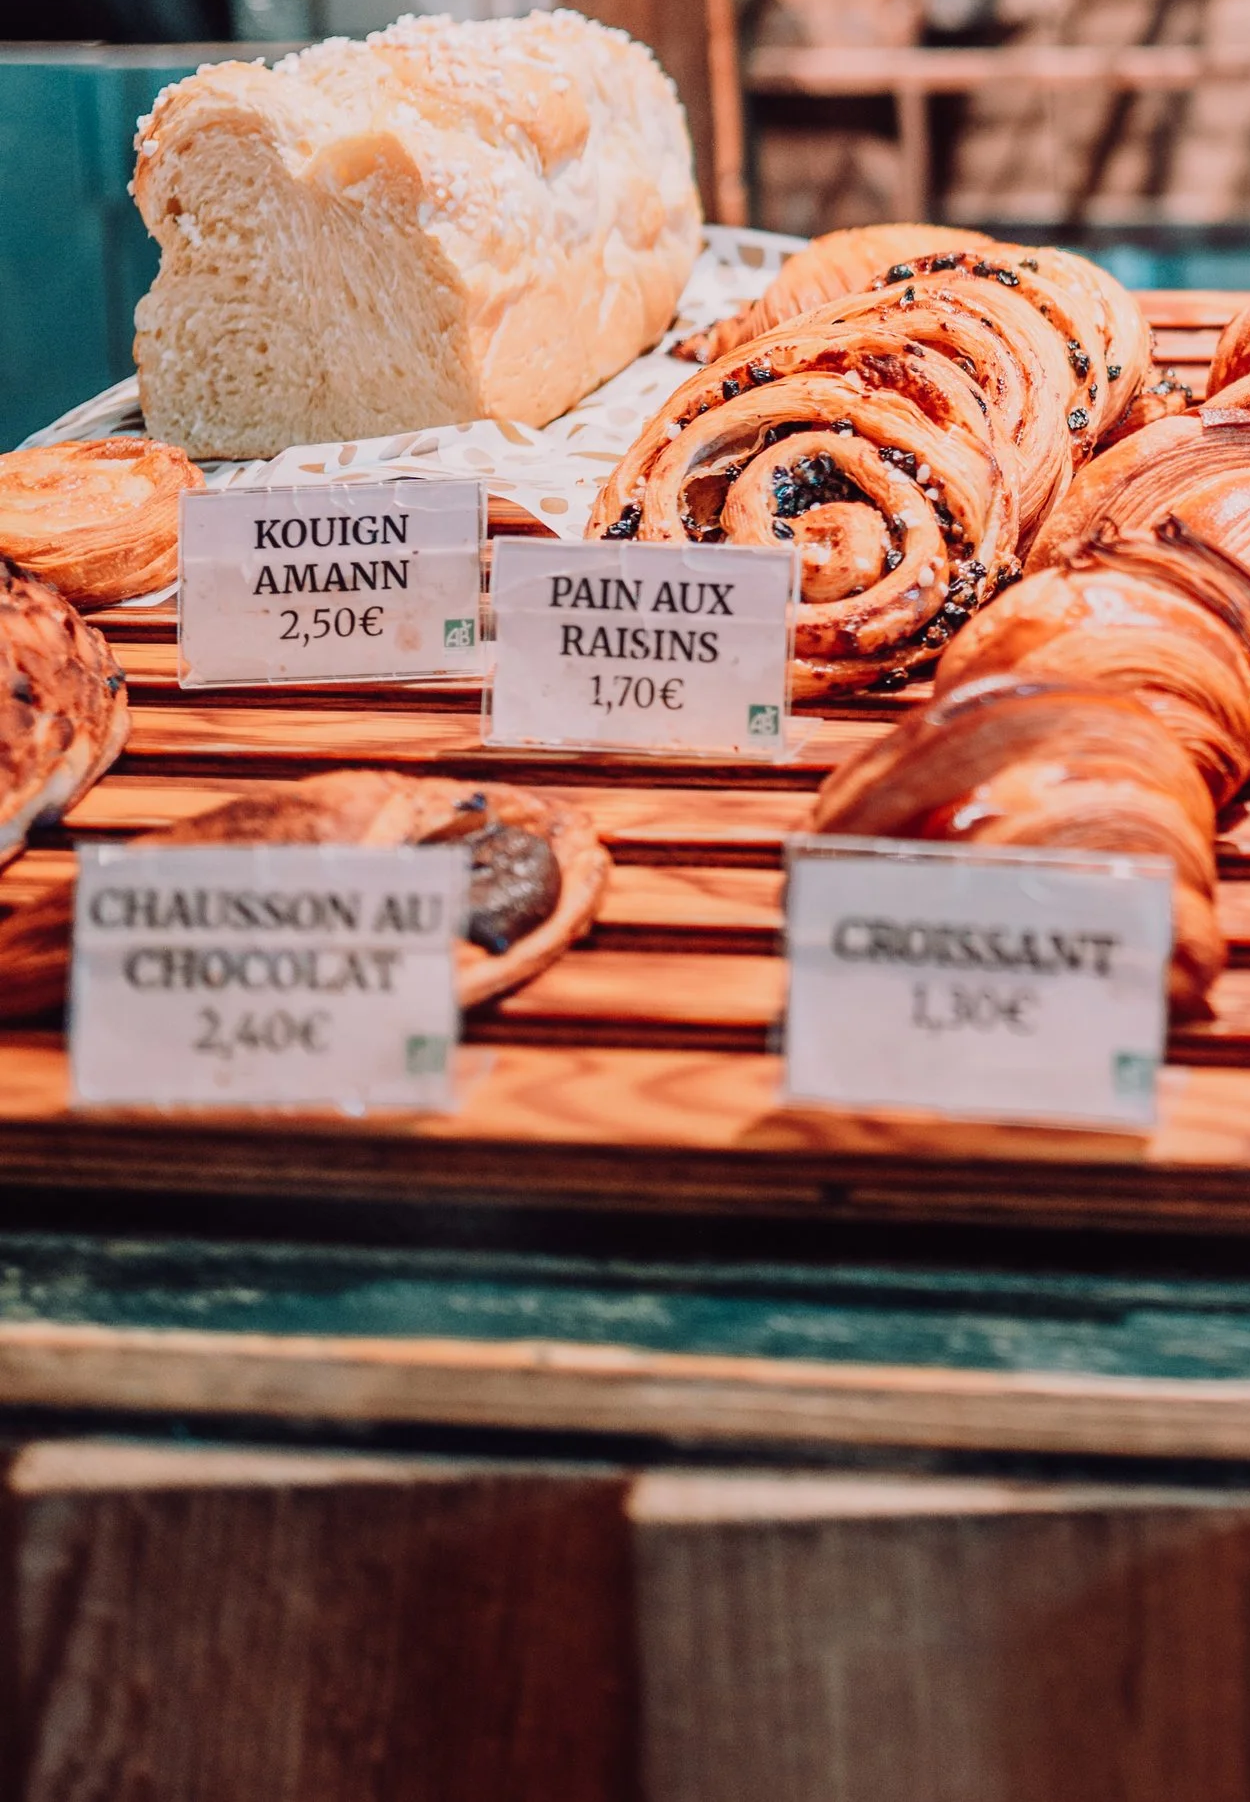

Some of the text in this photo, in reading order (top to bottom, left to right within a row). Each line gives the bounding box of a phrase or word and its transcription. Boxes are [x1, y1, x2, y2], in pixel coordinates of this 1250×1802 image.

[254, 514, 409, 550] KOUIGN
[252, 559, 410, 596] AMANN
[549, 575, 735, 616] PAIN AUX
[279, 606, 384, 648] 2,50€
[560, 625, 719, 664] RAISINS
[590, 674, 684, 714] 1,70€
[89, 888, 443, 933] CHAUSSON AU
[830, 915, 1119, 976] CROISSANT
[123, 946, 399, 993] CHOCOLAT
[193, 1006, 331, 1060] 2,40€
